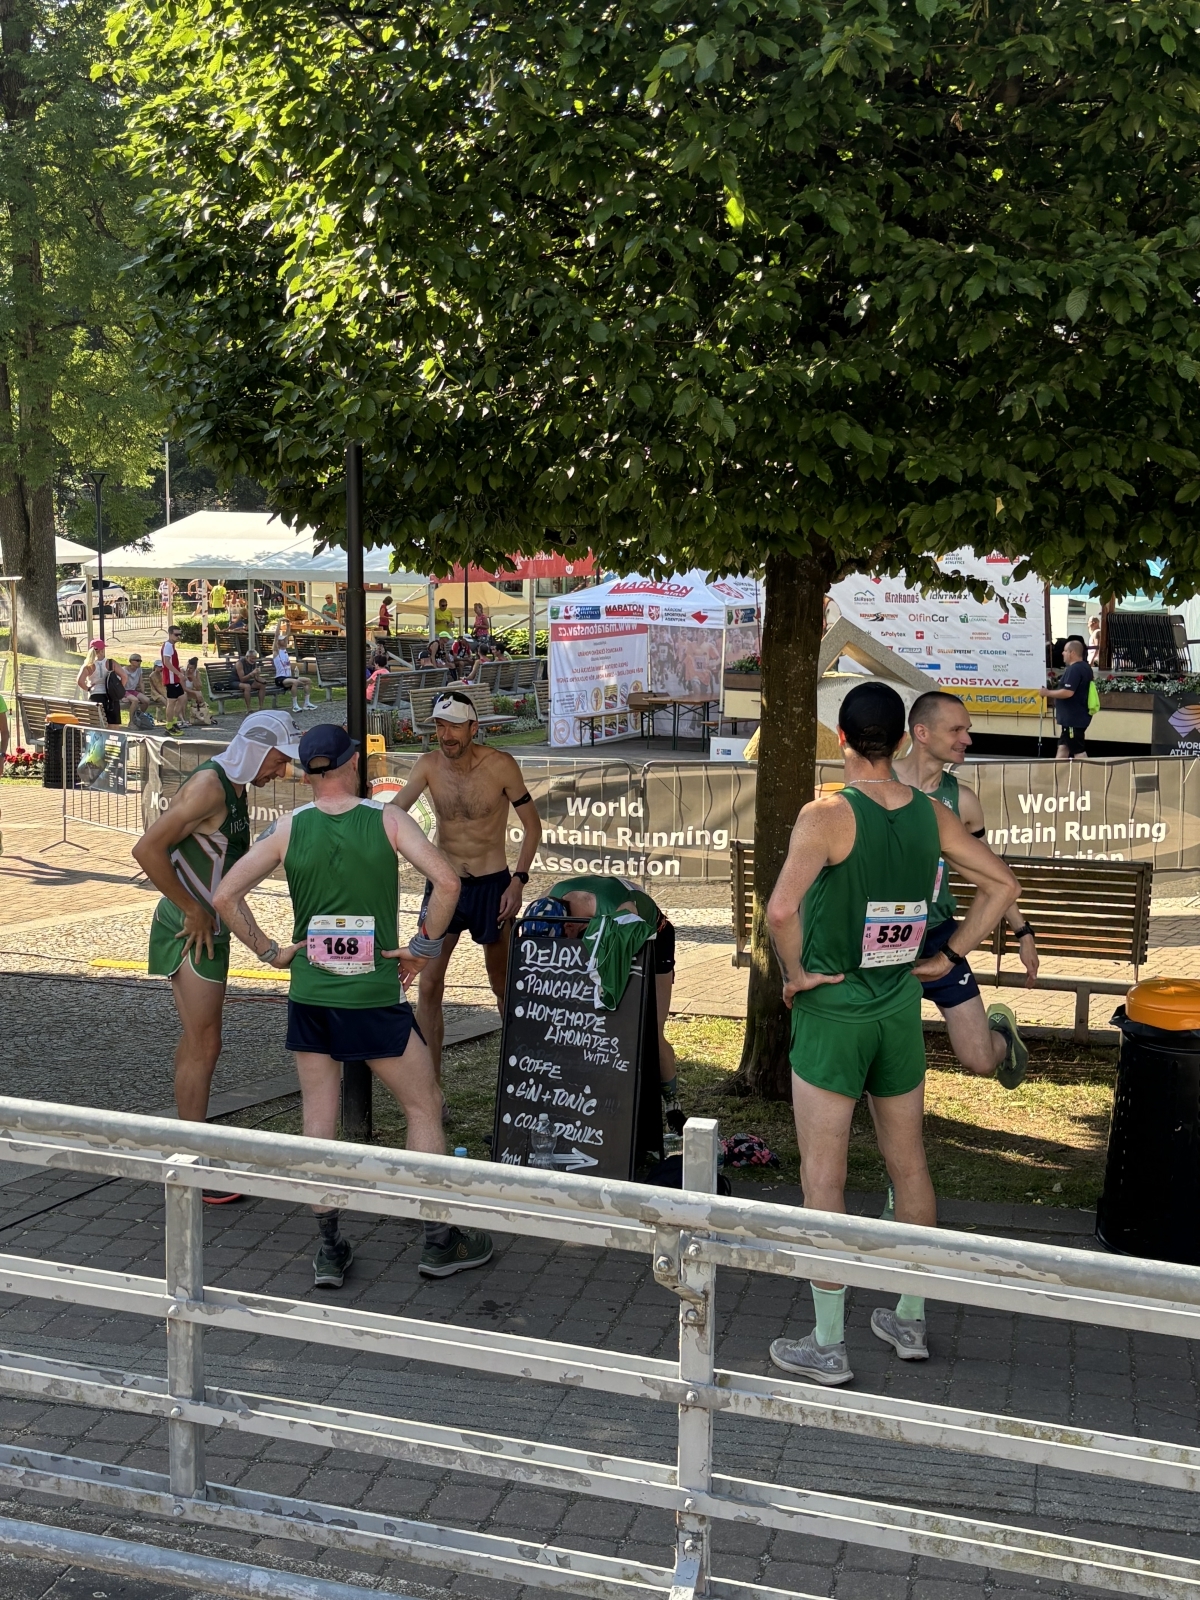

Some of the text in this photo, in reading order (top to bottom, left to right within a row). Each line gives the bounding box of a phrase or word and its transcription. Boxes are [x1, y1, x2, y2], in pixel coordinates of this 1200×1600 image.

[613, 580, 694, 595] MARATON
[605, 603, 644, 612] MARATON
[908, 613, 949, 622] OlfinCar
[975, 694, 1037, 704] REPUBLIKA
[566, 796, 644, 817] World
[1018, 791, 1091, 814] World
[617, 825, 729, 850] Running
[1065, 819, 1166, 842] Running
[529, 852, 680, 876] Association
[876, 924, 913, 943] 530
[323, 937, 359, 955] 168
[521, 940, 583, 968] RELAX
[526, 1001, 606, 1033] HOMEMADE
[519, 1056, 562, 1079] COFFE
[583, 1049, 610, 1065] WITH
